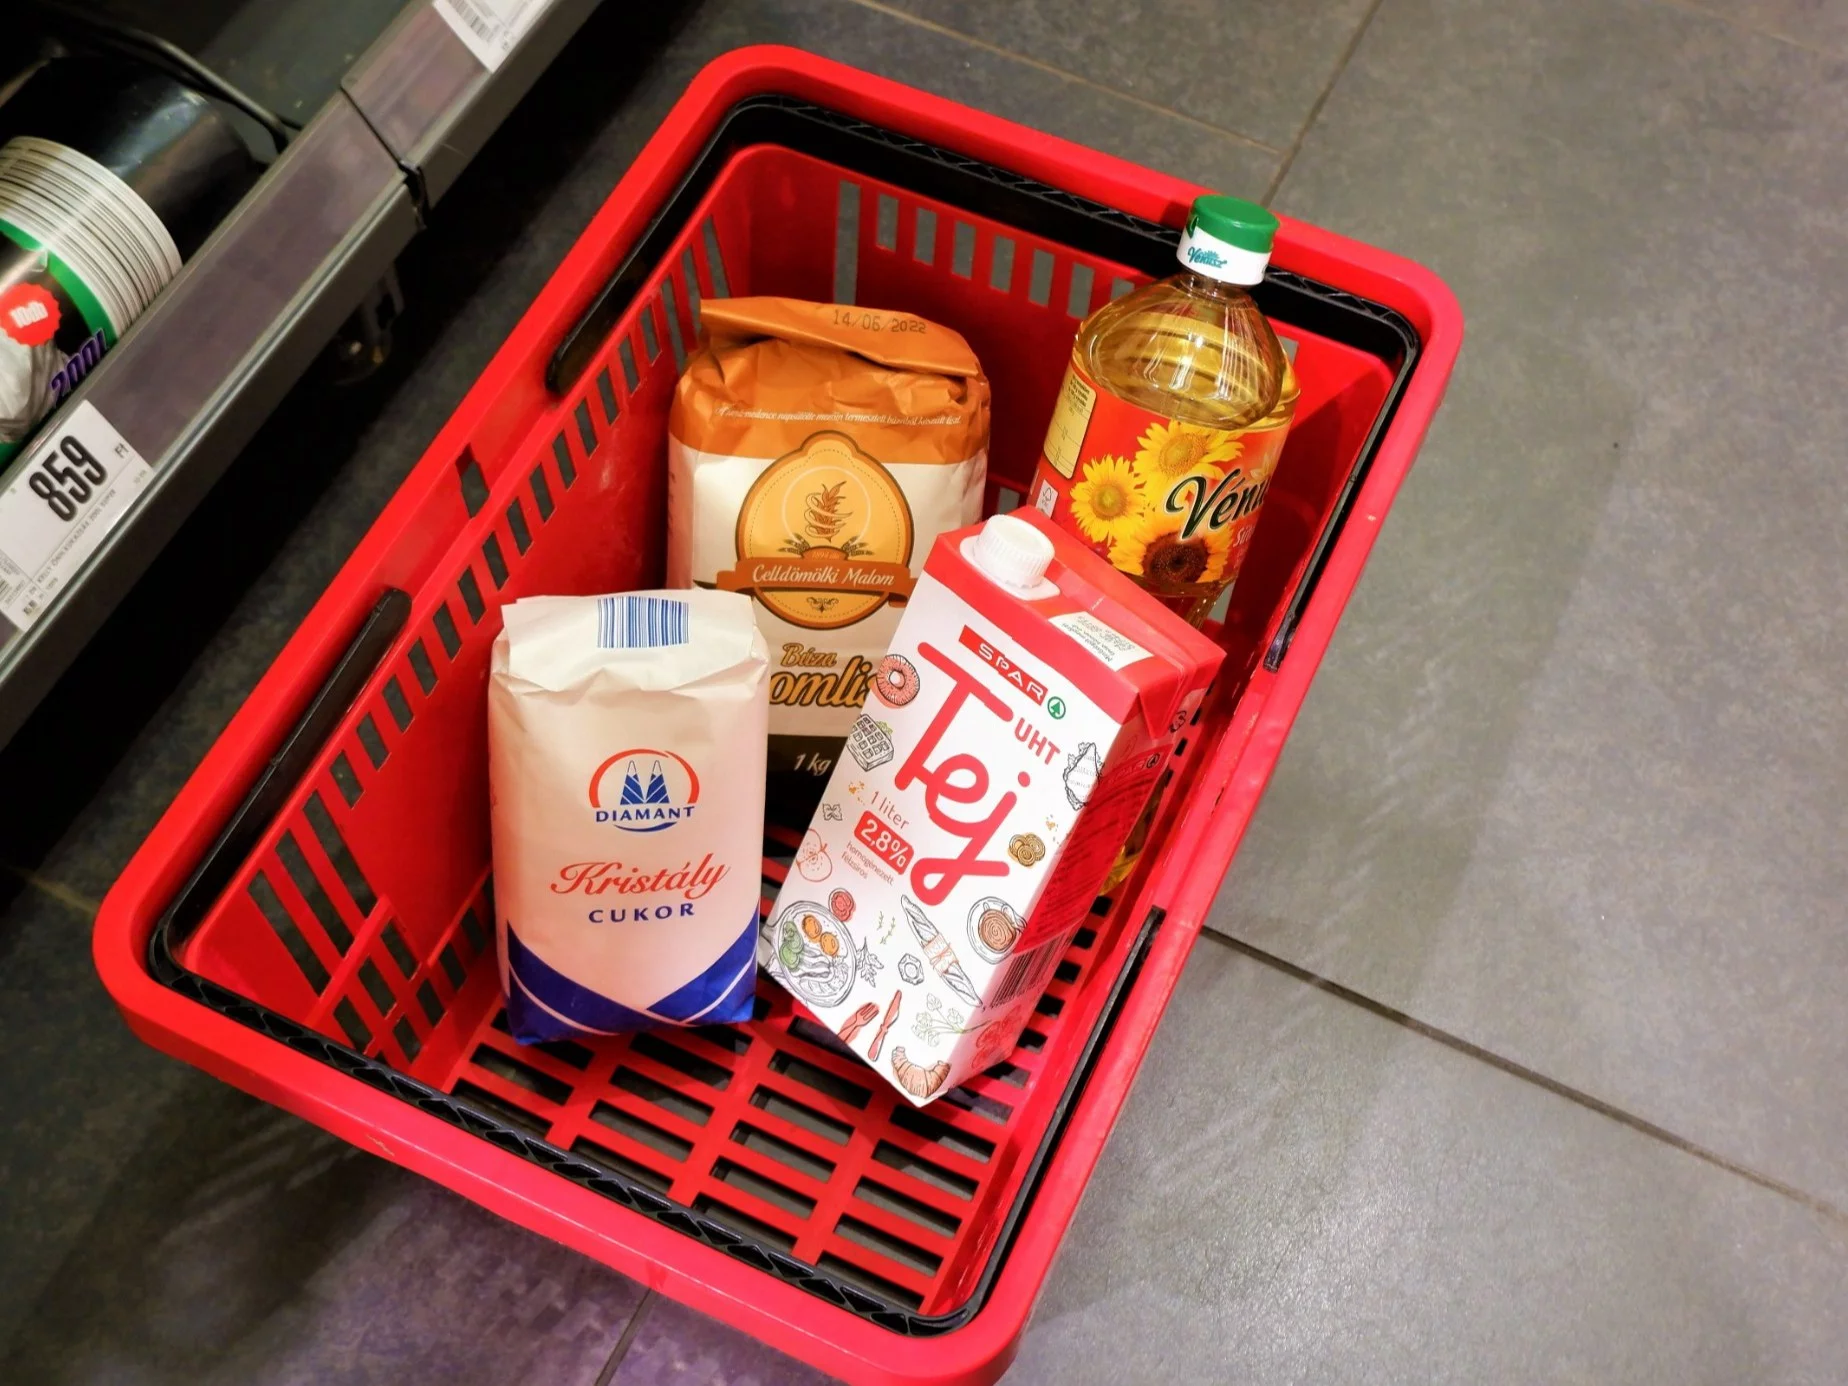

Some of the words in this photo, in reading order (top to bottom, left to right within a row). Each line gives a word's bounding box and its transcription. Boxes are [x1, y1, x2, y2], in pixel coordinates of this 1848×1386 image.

[833, 309, 927, 334] 14/06/2022
[29, 435, 108, 522] 859
[114, 442, 130, 458] Ft
[1165, 468, 1270, 540] Vénu
[753, 564, 839, 584] Celldömölki
[841, 567, 895, 587] Malom
[780, 642, 837, 668] Búza
[979, 642, 1045, 701] SPAR
[1015, 717, 1061, 765] UHT
[794, 752, 807, 771] 1
[807, 752, 832, 777] kg
[894, 642, 1031, 906] Tej
[596, 806, 695, 823] DIAMANT
[871, 790, 880, 805] 1
[879, 797, 909, 829] liter
[860, 818, 909, 868] 2,8%
[550, 852, 731, 900] Kristály
[589, 902, 695, 923] CUKOR
